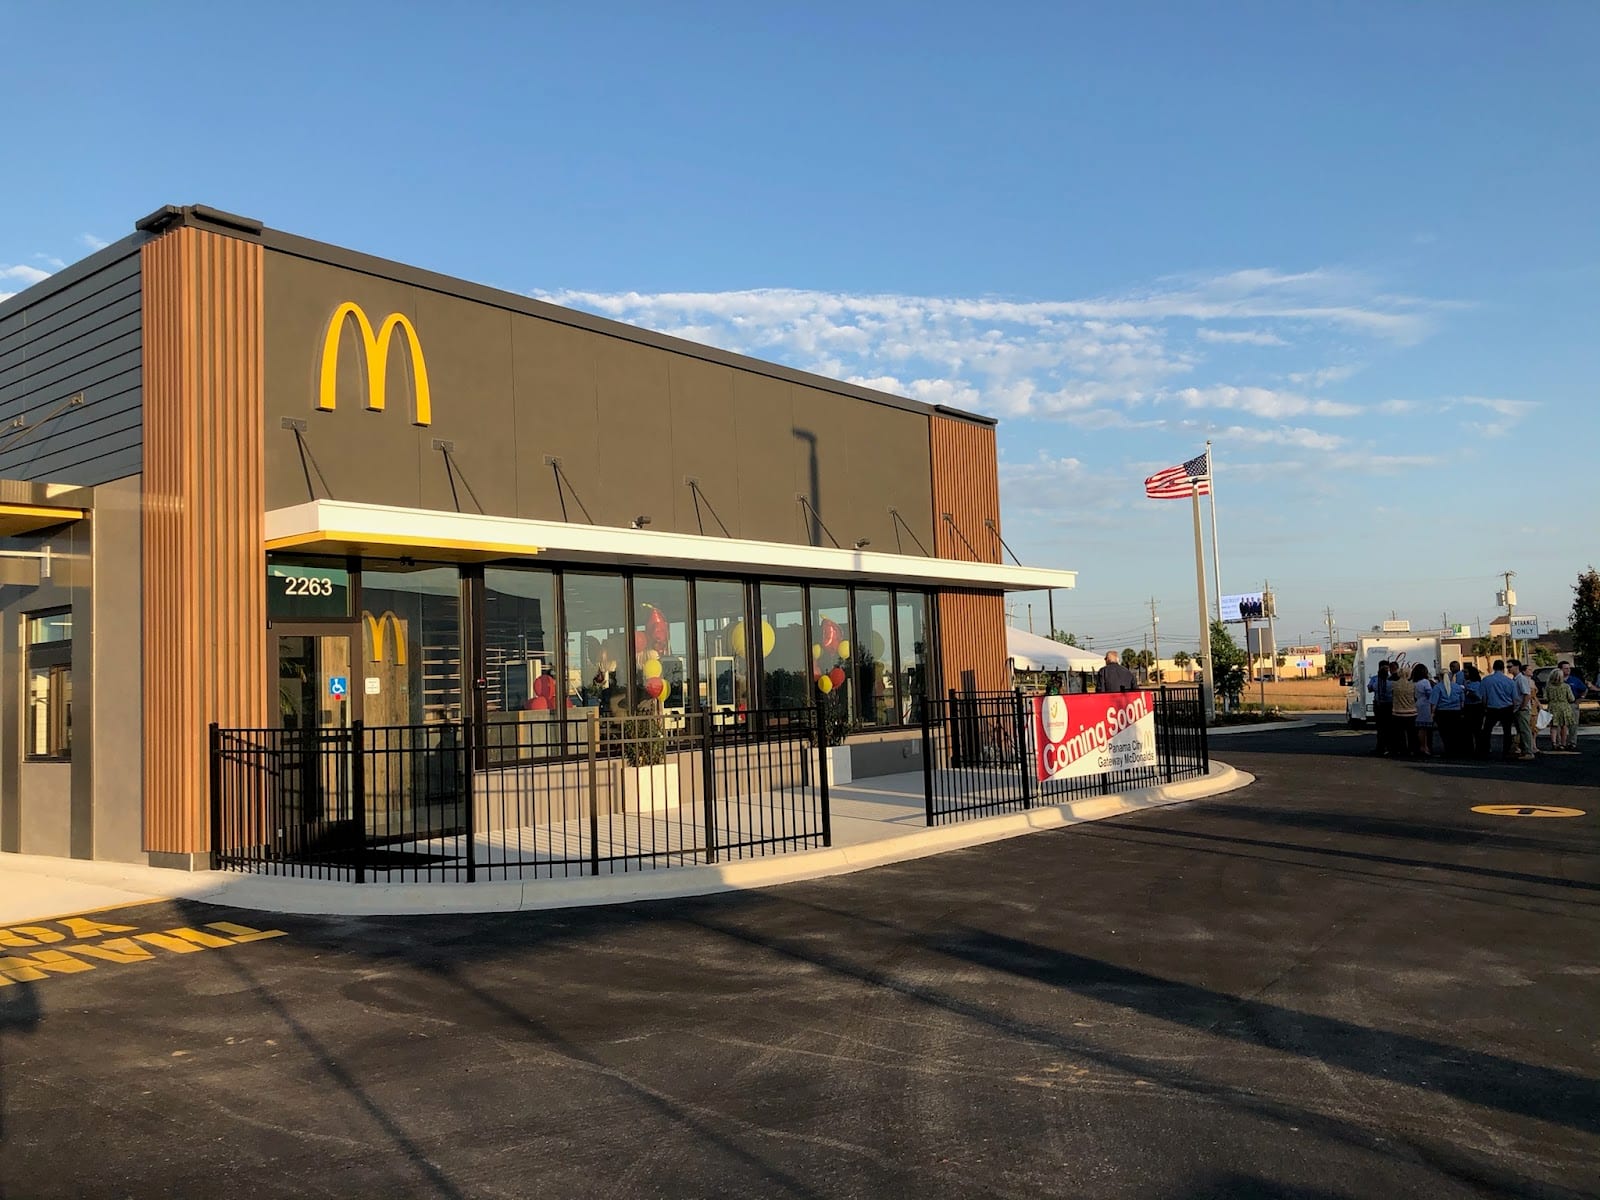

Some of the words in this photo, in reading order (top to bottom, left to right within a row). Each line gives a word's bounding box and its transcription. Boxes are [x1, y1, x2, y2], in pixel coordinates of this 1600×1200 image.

[285, 577, 333, 596] 2263
[1043, 720, 1108, 775] Coming
[1106, 691, 1148, 736] Soon!
[1108, 742, 1131, 753] Panama
[1132, 740, 1143, 752] City
[1098, 756, 1123, 768] Gateway
[0, 921, 289, 987] THAN
